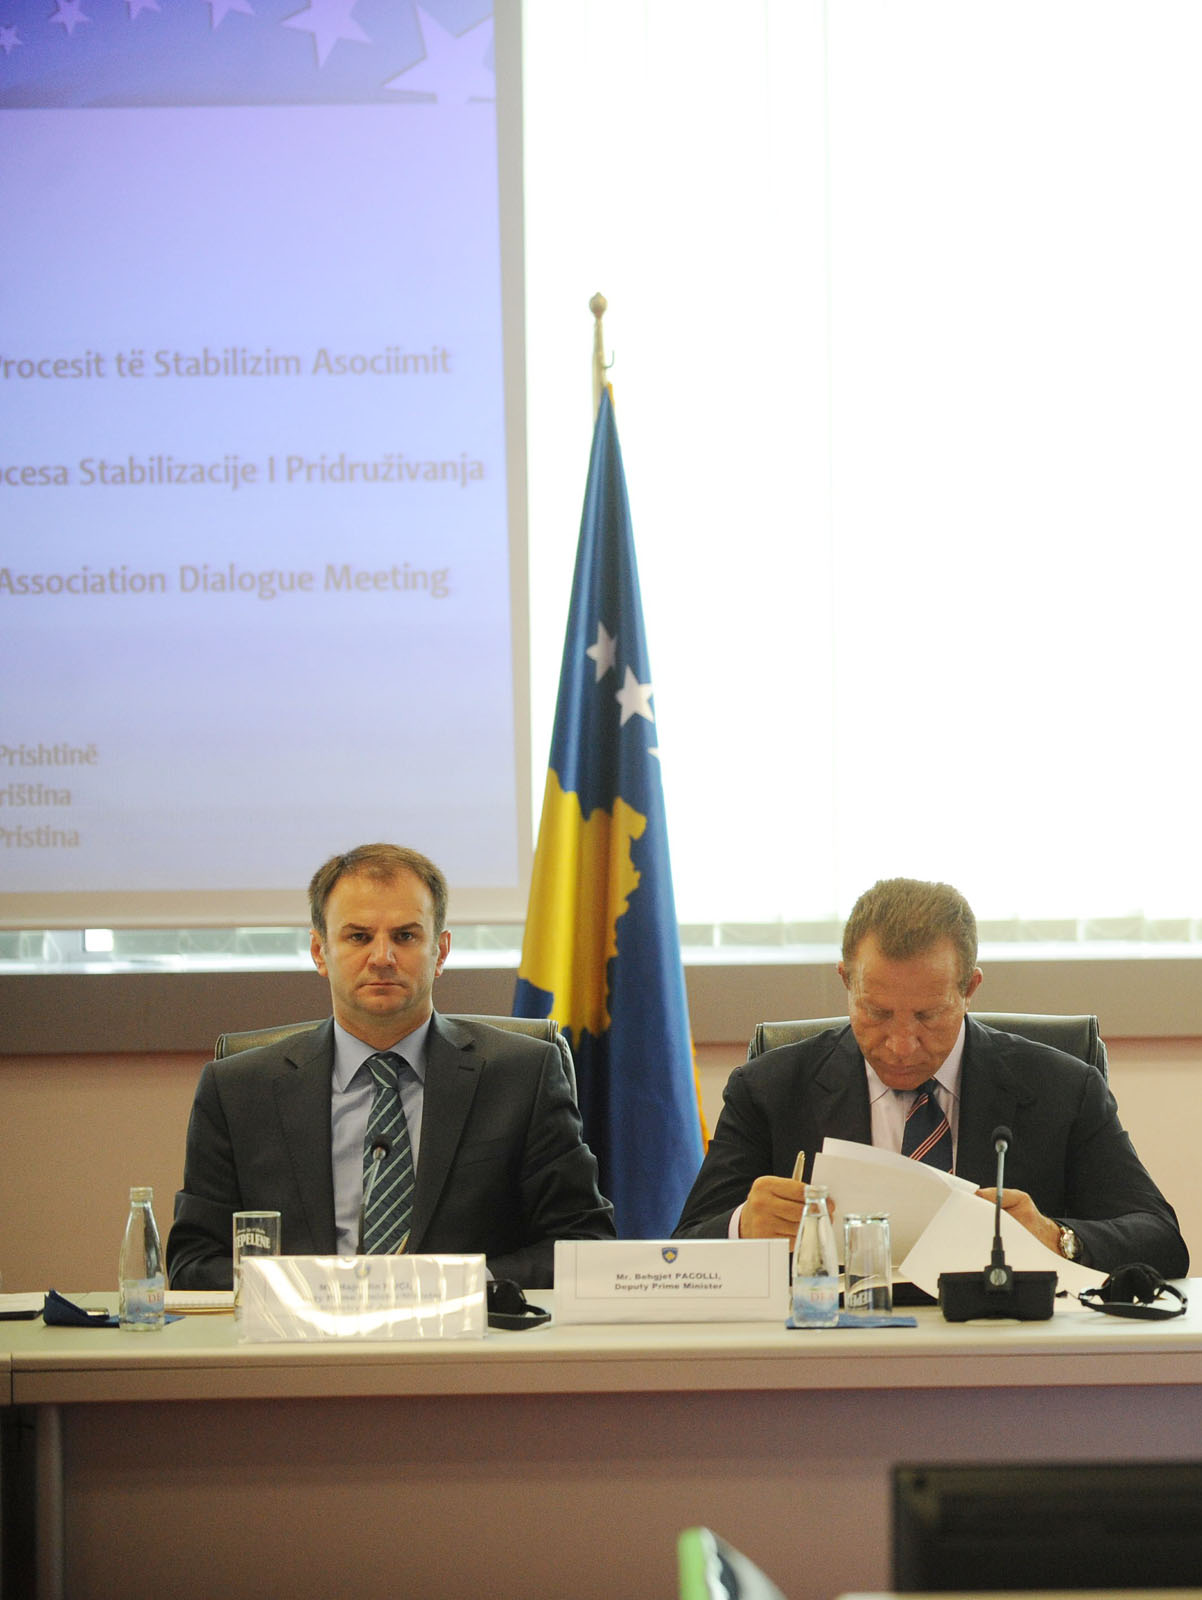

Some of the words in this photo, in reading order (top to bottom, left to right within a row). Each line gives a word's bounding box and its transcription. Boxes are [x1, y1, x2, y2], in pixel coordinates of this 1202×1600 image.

[114, 348, 145, 378] të
[153, 346, 301, 378] Stabilizim
[312, 345, 453, 376] Asociimit
[79, 455, 257, 491] Stabilizacije
[286, 451, 485, 488] Pridruživanja
[0, 565, 166, 597] Association
[179, 562, 315, 600] Dialogue
[324, 562, 451, 600] Meeting
[614, 1283, 648, 1291] Deputy
[683, 1282, 723, 1290] Minister
[616, 1273, 631, 1281] Mr.
[675, 1272, 722, 1281] PACOLLI,
